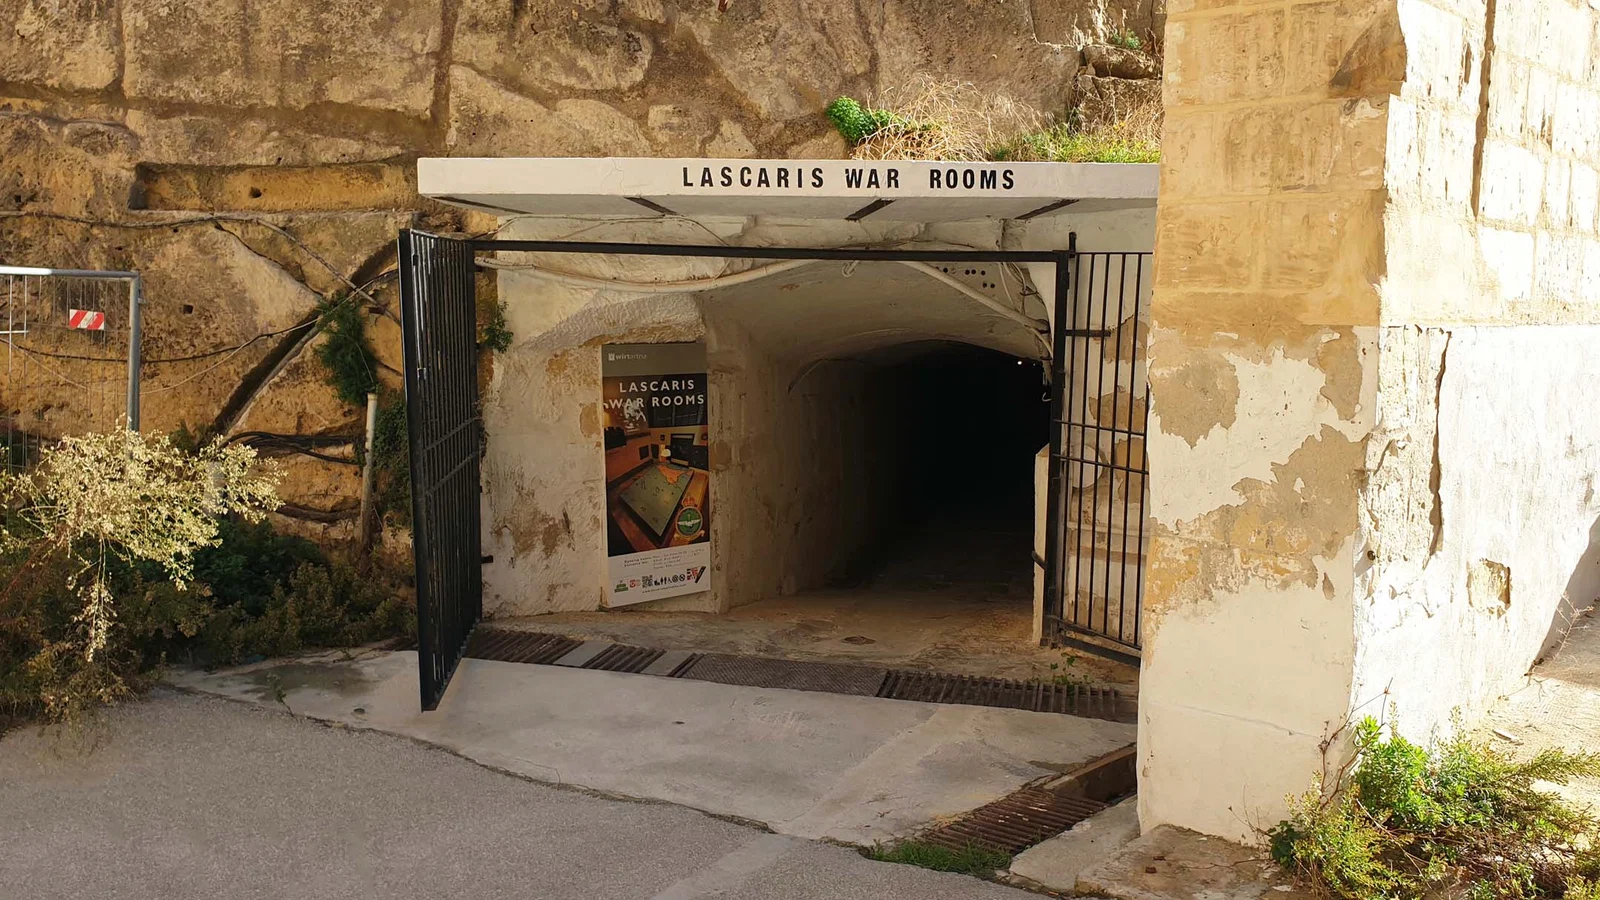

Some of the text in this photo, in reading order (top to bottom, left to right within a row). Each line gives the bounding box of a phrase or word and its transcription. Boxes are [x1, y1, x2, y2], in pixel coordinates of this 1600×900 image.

[683, 167, 1014, 189] LASCARIS WAR ROOMS
[619, 379, 695, 393] LASCARIS
[608, 394, 704, 409] WAR ROOMS
